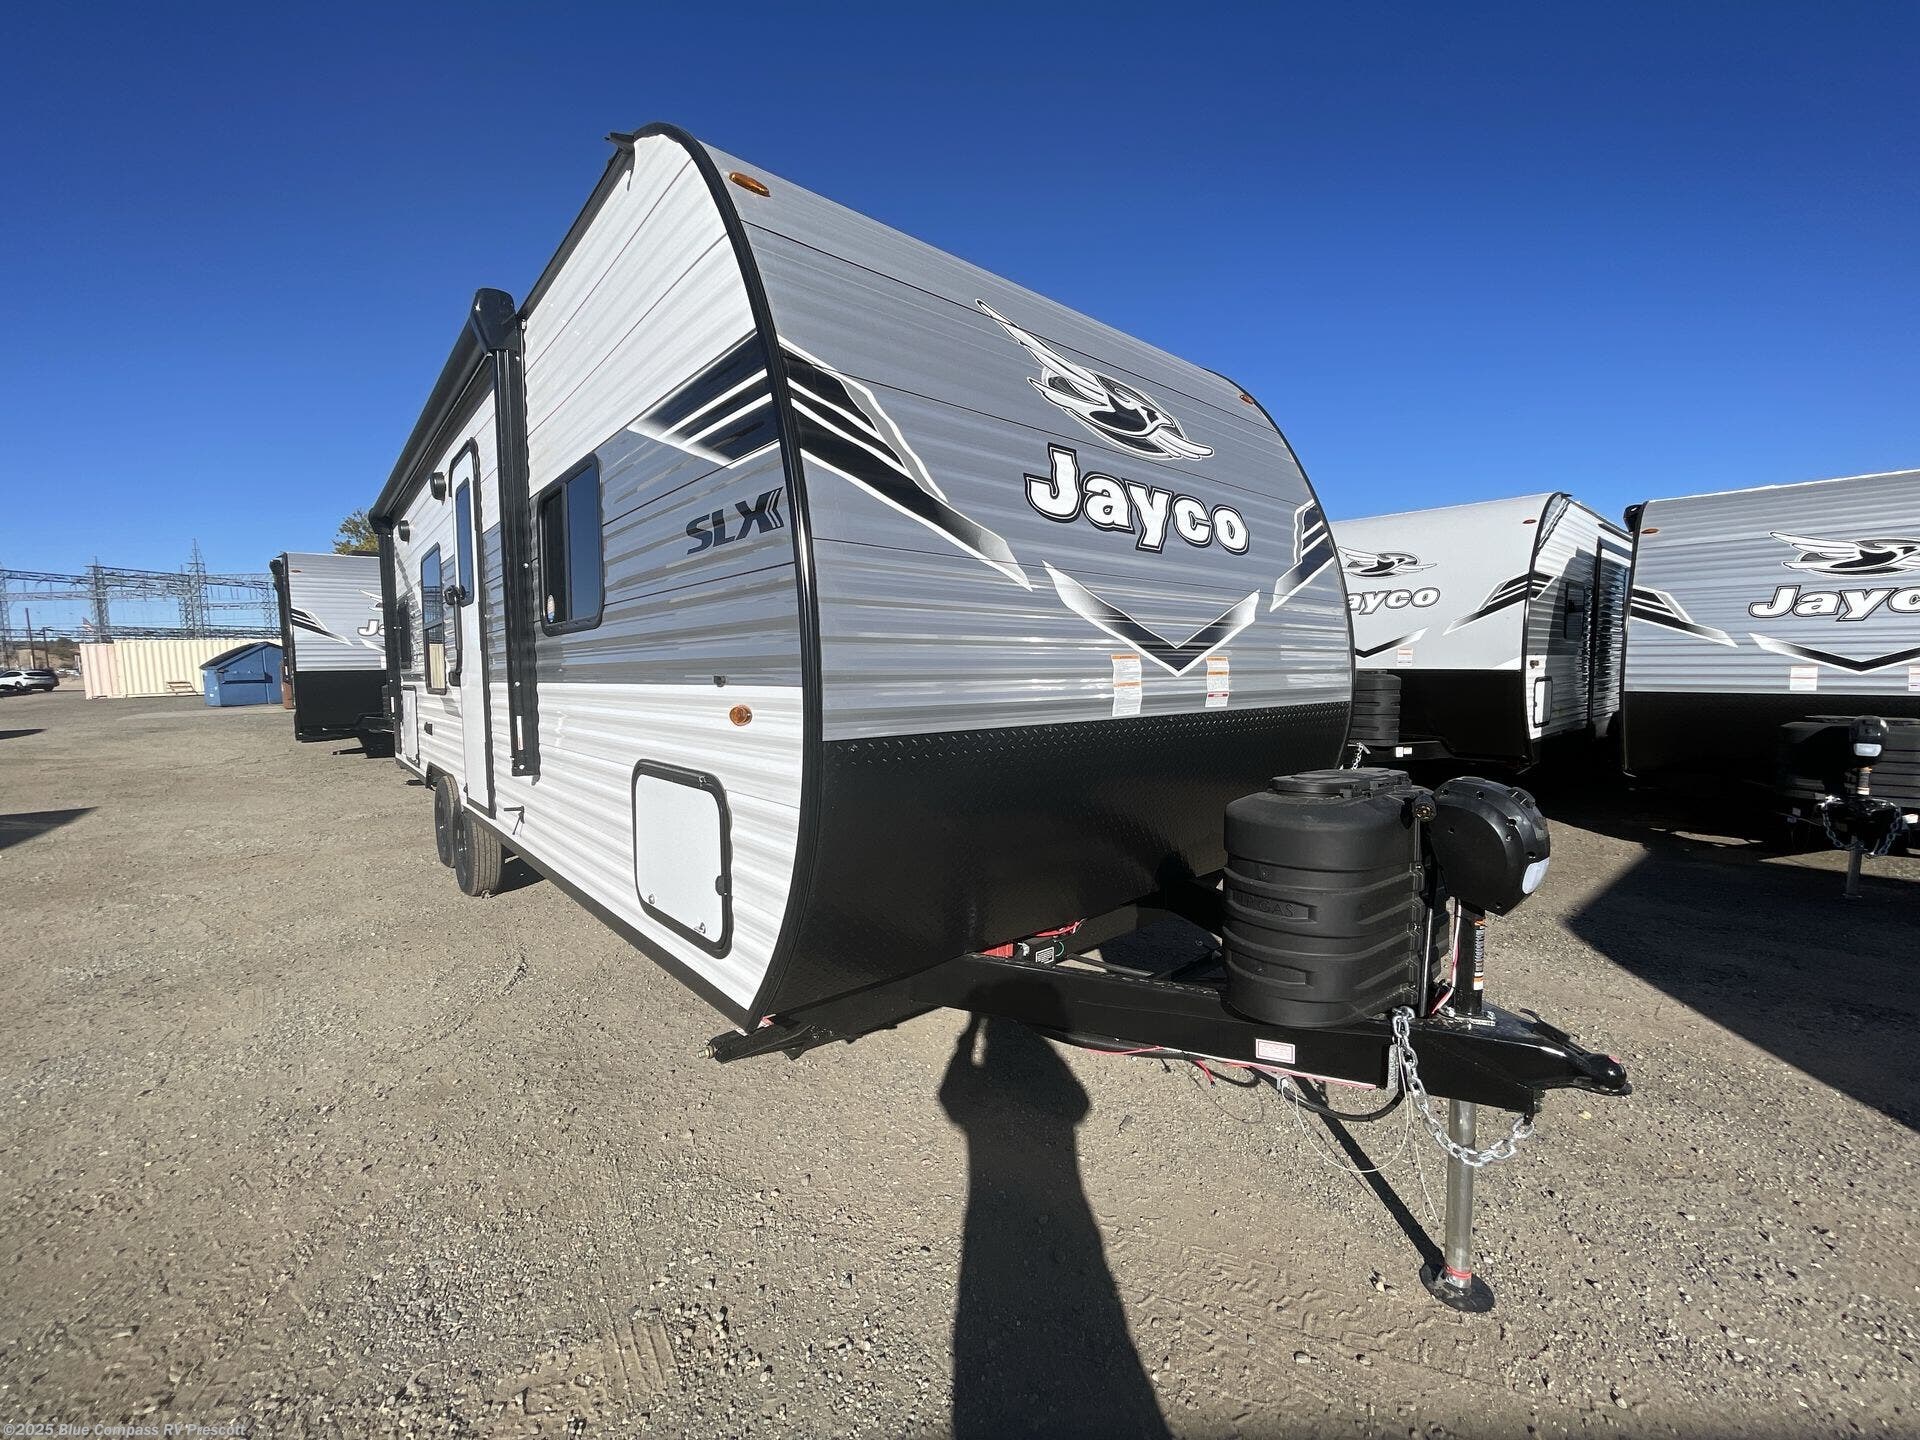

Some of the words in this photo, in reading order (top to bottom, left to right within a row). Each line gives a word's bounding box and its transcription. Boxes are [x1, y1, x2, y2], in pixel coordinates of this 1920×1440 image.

[686, 486, 784, 555] SLX
[1023, 442, 1250, 555] Jayco
[1348, 587, 1441, 615] ayco
[1748, 585, 1920, 622] Jayc
